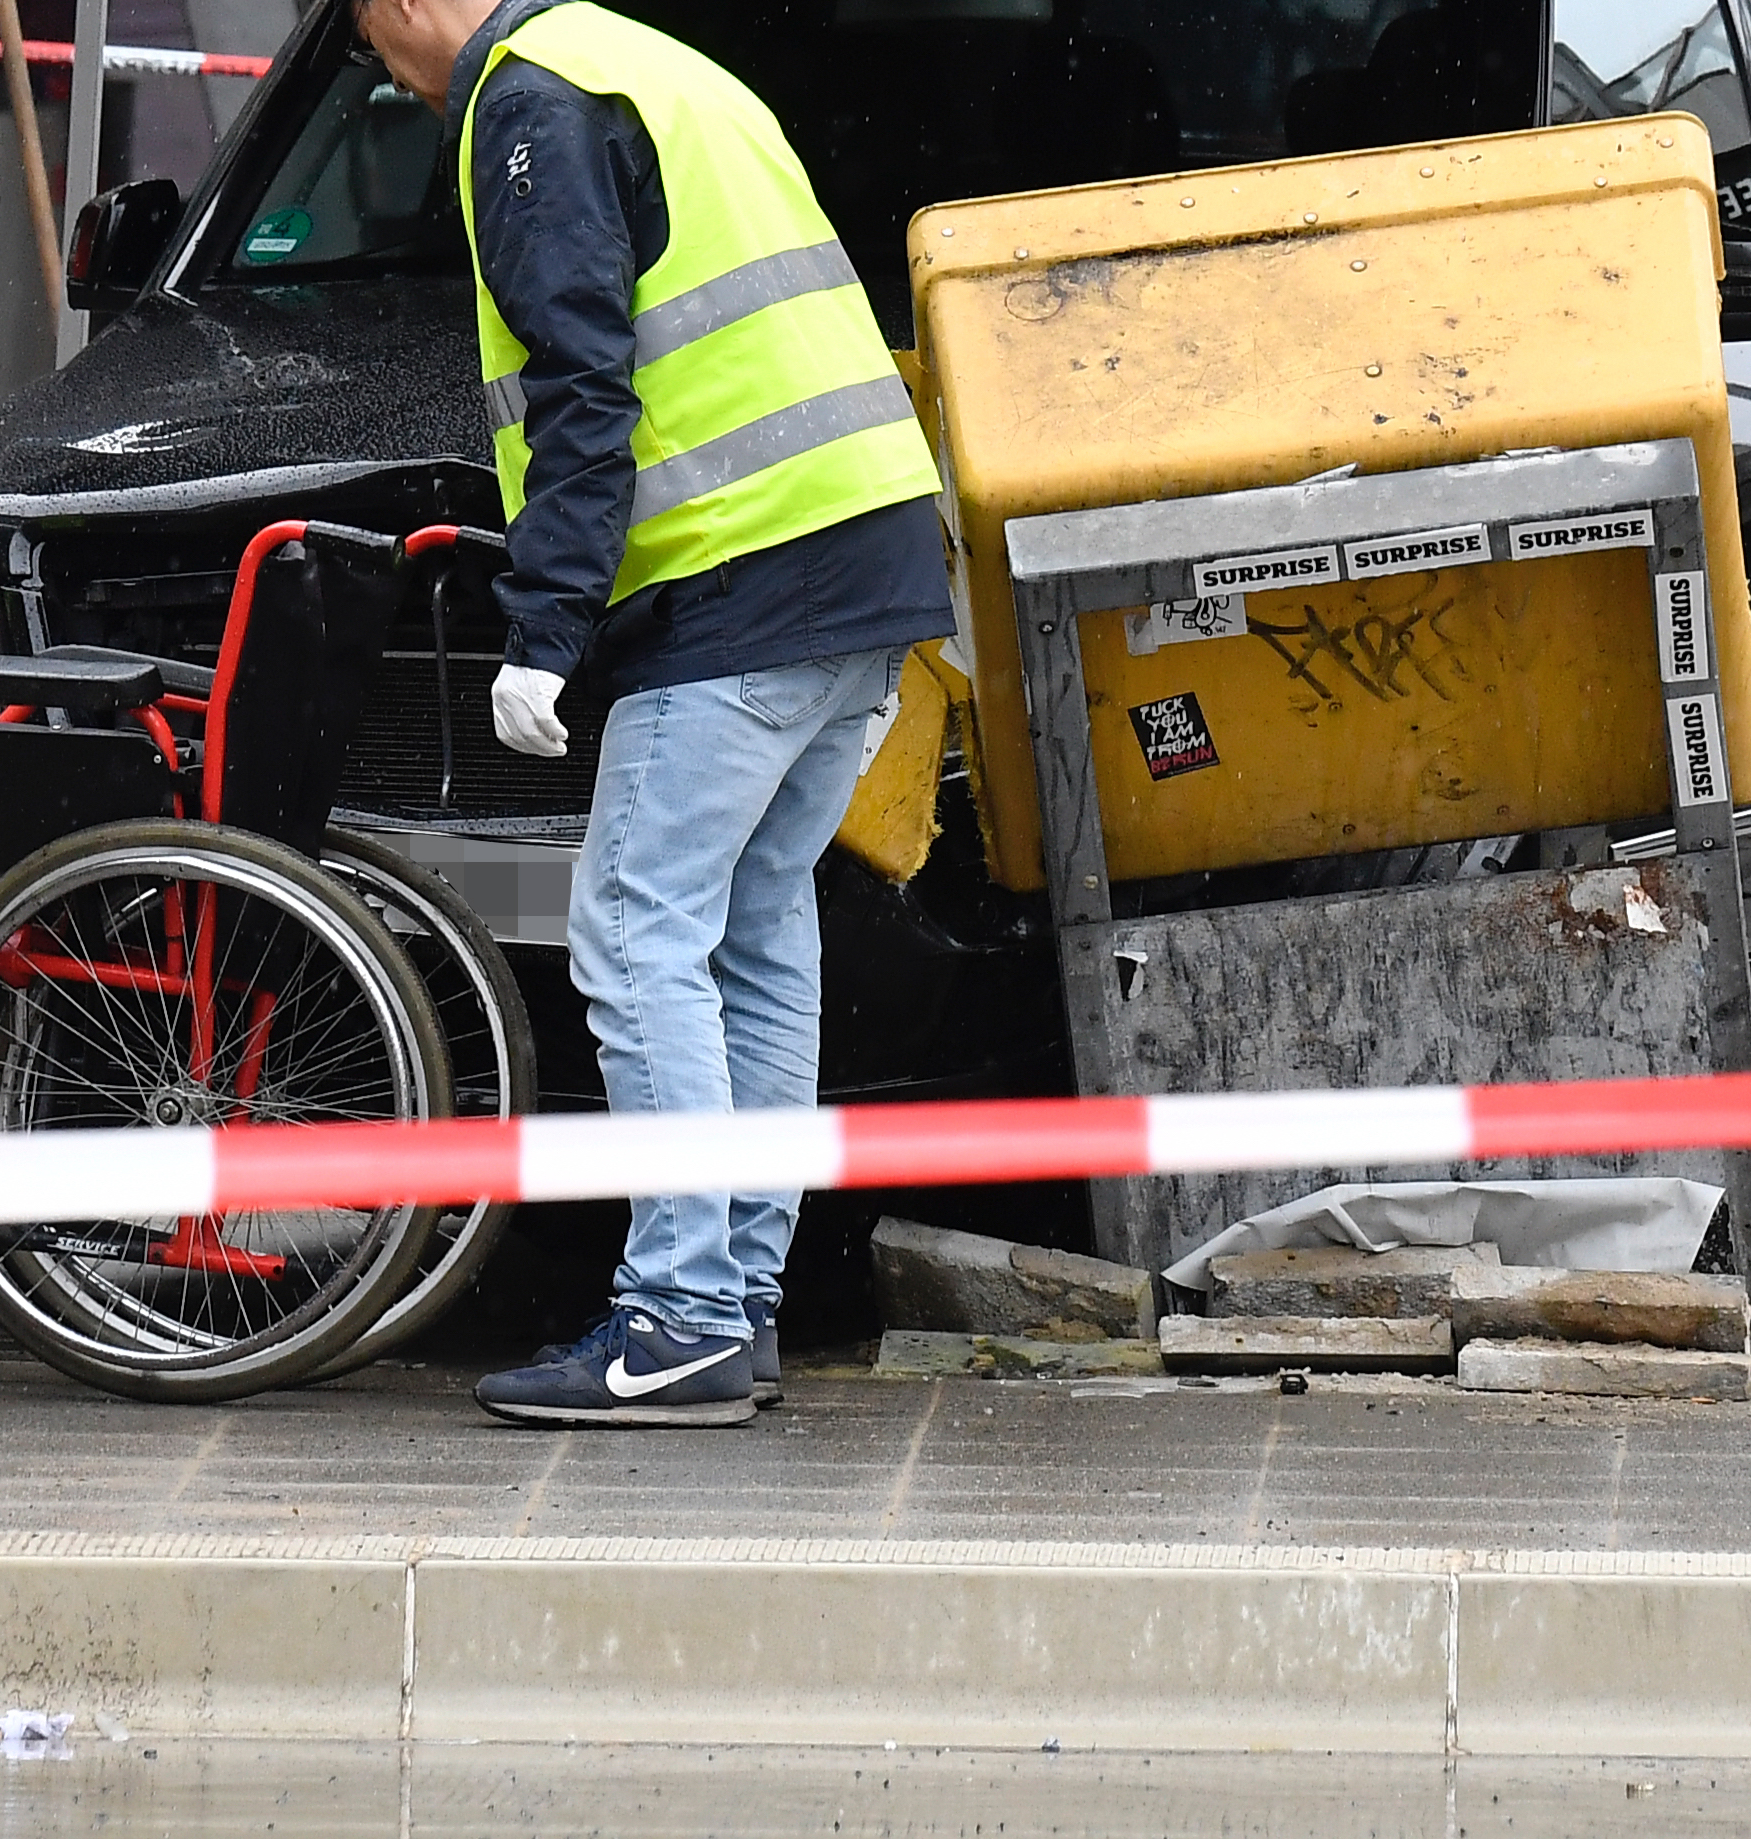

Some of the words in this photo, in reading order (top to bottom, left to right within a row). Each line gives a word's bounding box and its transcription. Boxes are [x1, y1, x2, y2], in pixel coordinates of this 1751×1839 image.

[1518, 518, 1646, 551] SURPRISE
[1354, 534, 1483, 570] SURPRISE
[1202, 555, 1331, 588] SURPRISE
[1669, 577, 1696, 677] SURPRISE
[1146, 709, 1187, 732] YOU
[1162, 720, 1194, 743] AM
[1681, 701, 1714, 800] SURPRISE
